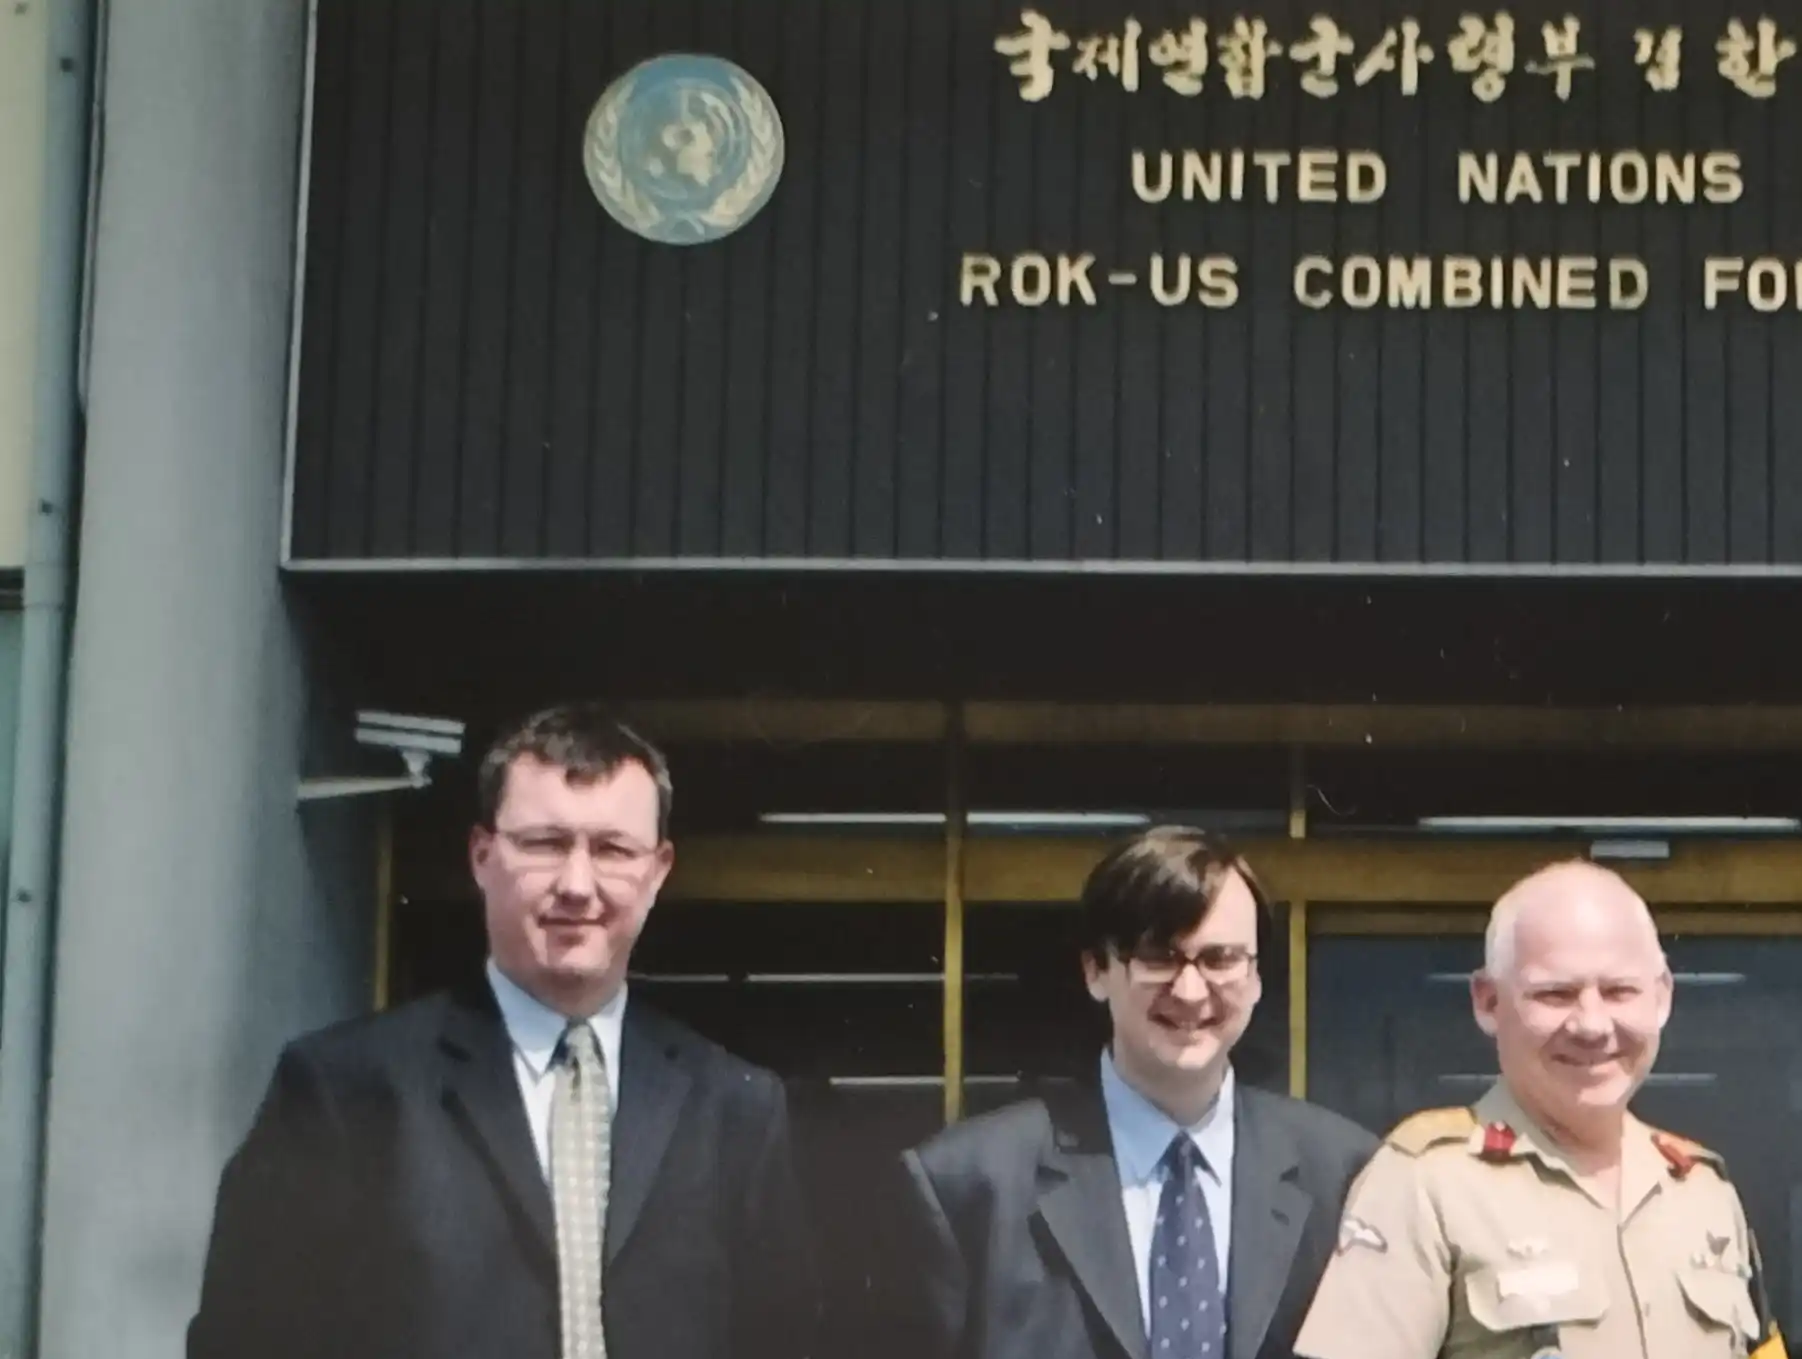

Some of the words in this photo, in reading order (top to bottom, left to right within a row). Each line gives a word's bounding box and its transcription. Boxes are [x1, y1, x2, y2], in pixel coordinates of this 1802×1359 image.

[1131, 150, 1387, 204] UNITED
[1457, 151, 1744, 205] NATIONS
[959, 253, 1240, 308] ROK-US
[1293, 255, 1649, 310] COMBINED
